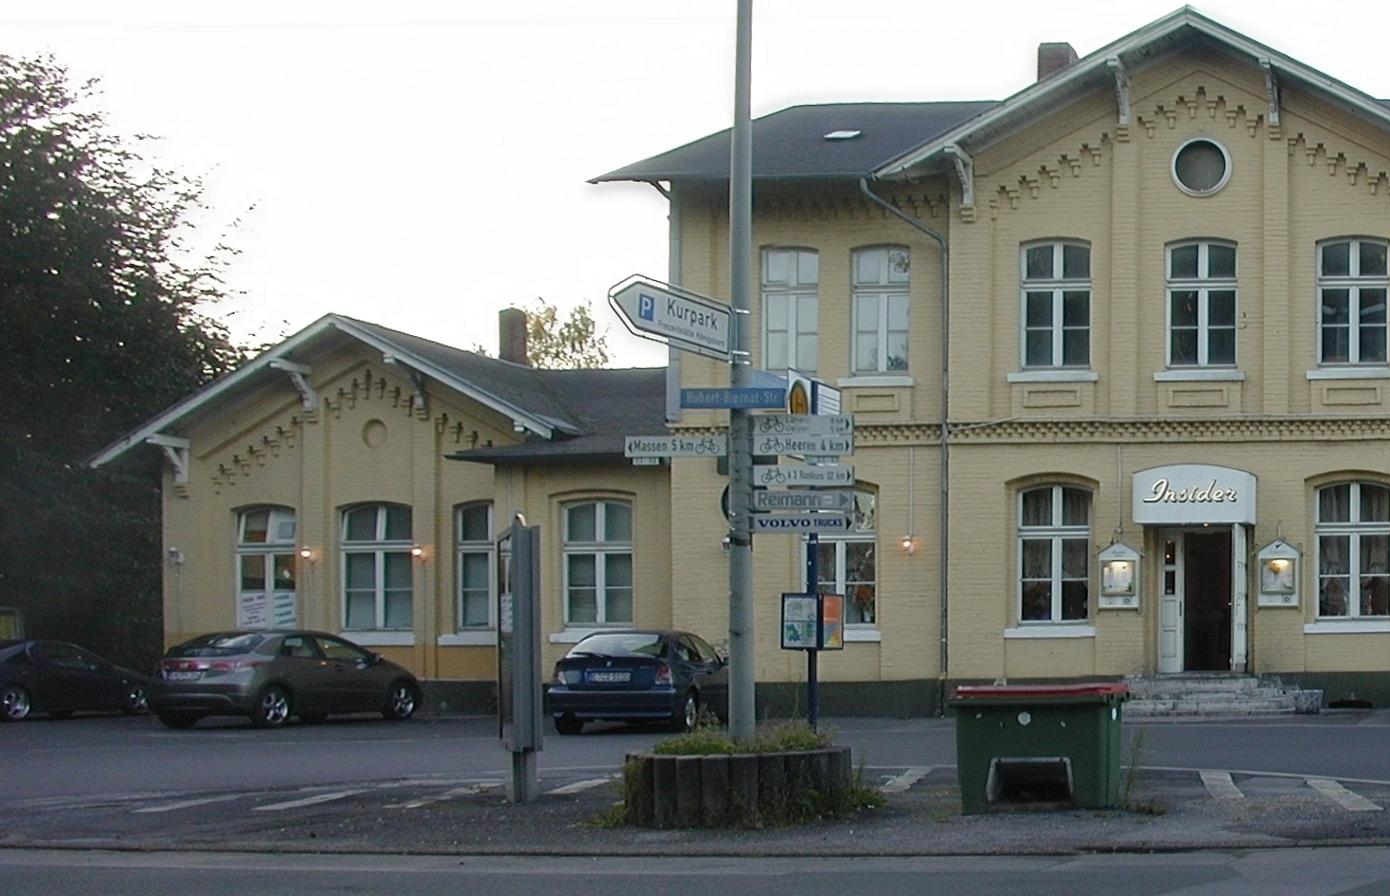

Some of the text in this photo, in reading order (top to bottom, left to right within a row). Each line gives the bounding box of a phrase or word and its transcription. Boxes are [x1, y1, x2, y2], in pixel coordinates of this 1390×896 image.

[641, 297, 718, 330] P Kurpark
[634, 440, 695, 452] Massen 5 km
[820, 440, 826, 451] 4
[829, 440, 844, 451] km
[1143, 478, 1238, 503] Insider
[758, 493, 822, 507] Reimann
[760, 518, 843, 528] VOLVO TRUCKS
